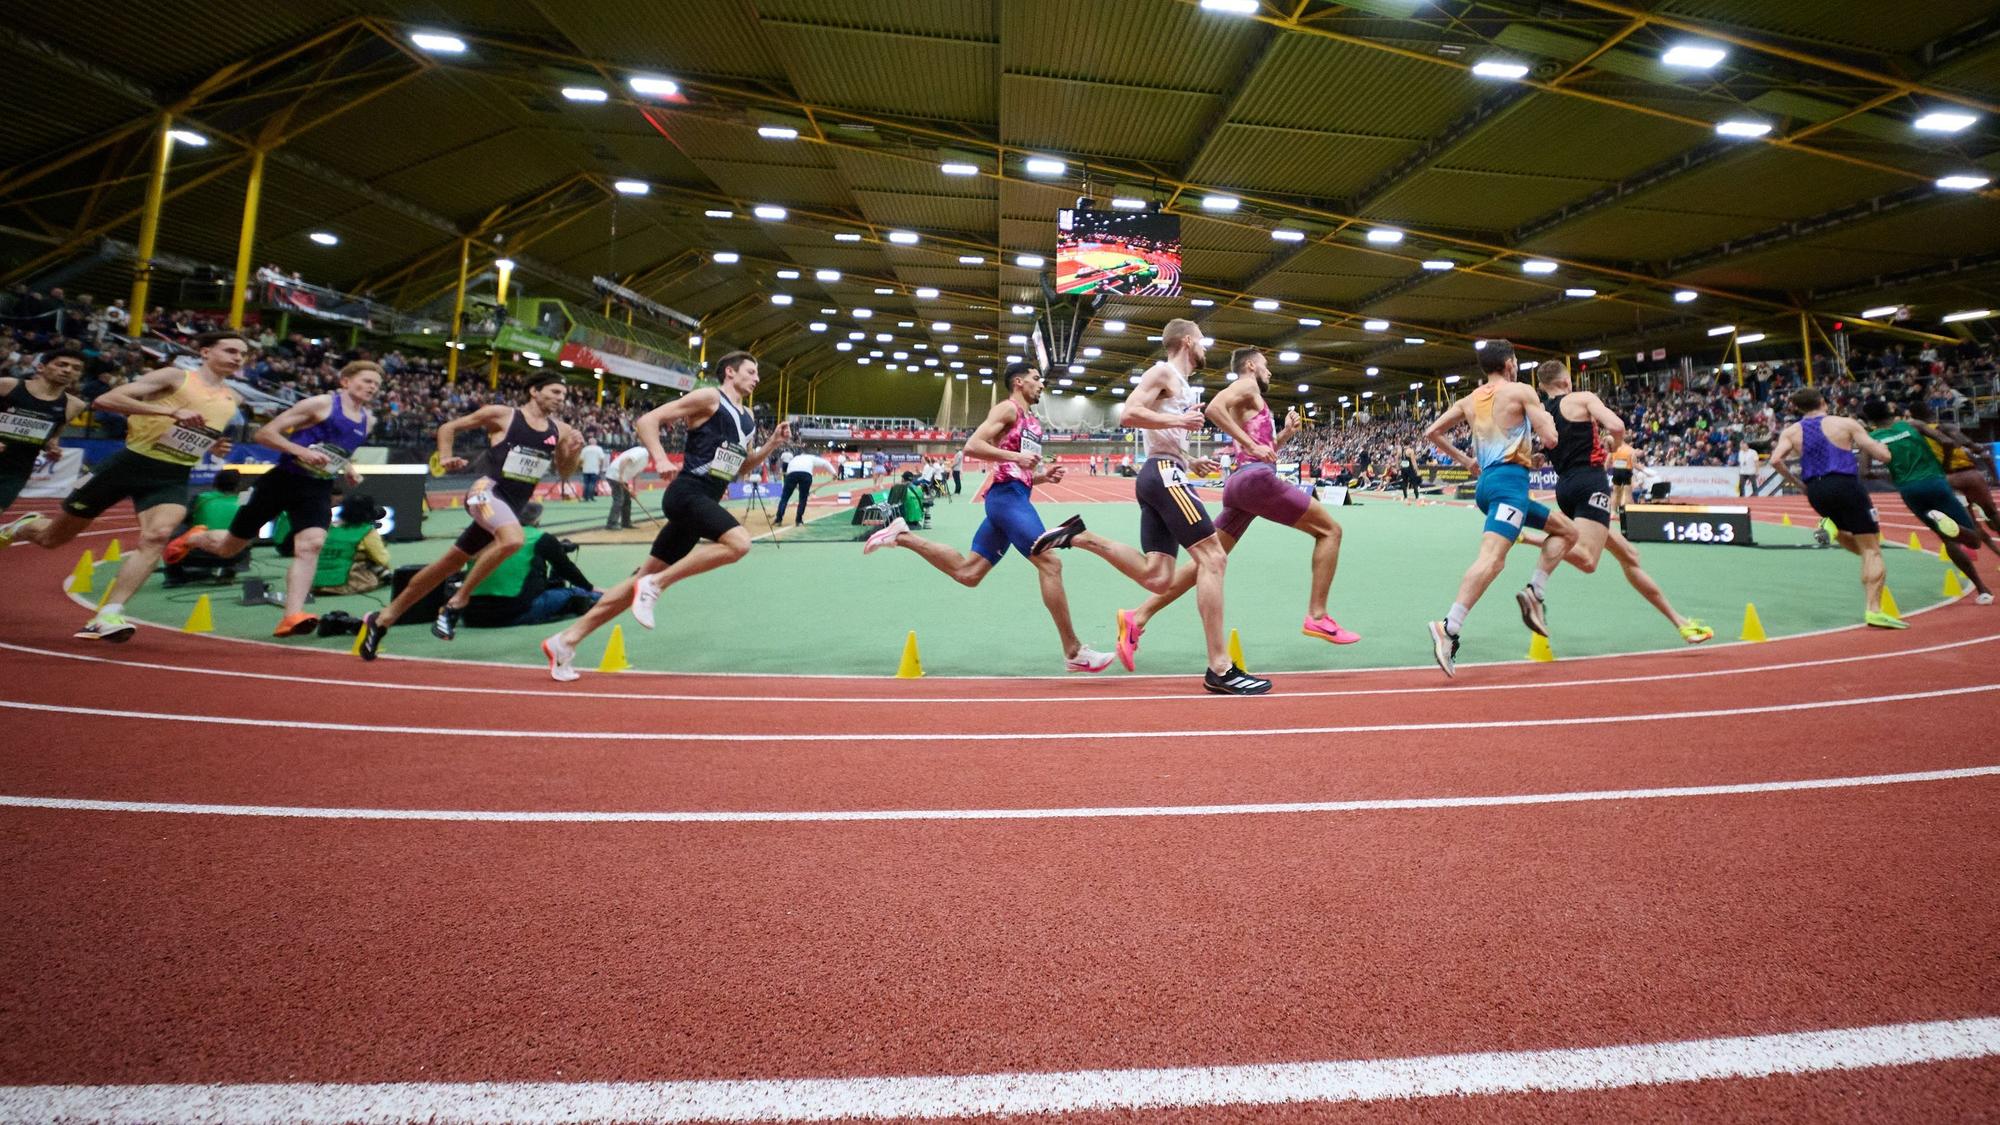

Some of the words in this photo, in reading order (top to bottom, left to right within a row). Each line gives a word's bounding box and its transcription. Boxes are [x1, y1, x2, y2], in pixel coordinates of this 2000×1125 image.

[172, 429, 212, 448] TOBLER
[1172, 470, 1182, 483] 4
[1594, 494, 1609, 509] 13
[1506, 507, 1517, 521] 7
[1663, 521, 1735, 543] 1:48.3
